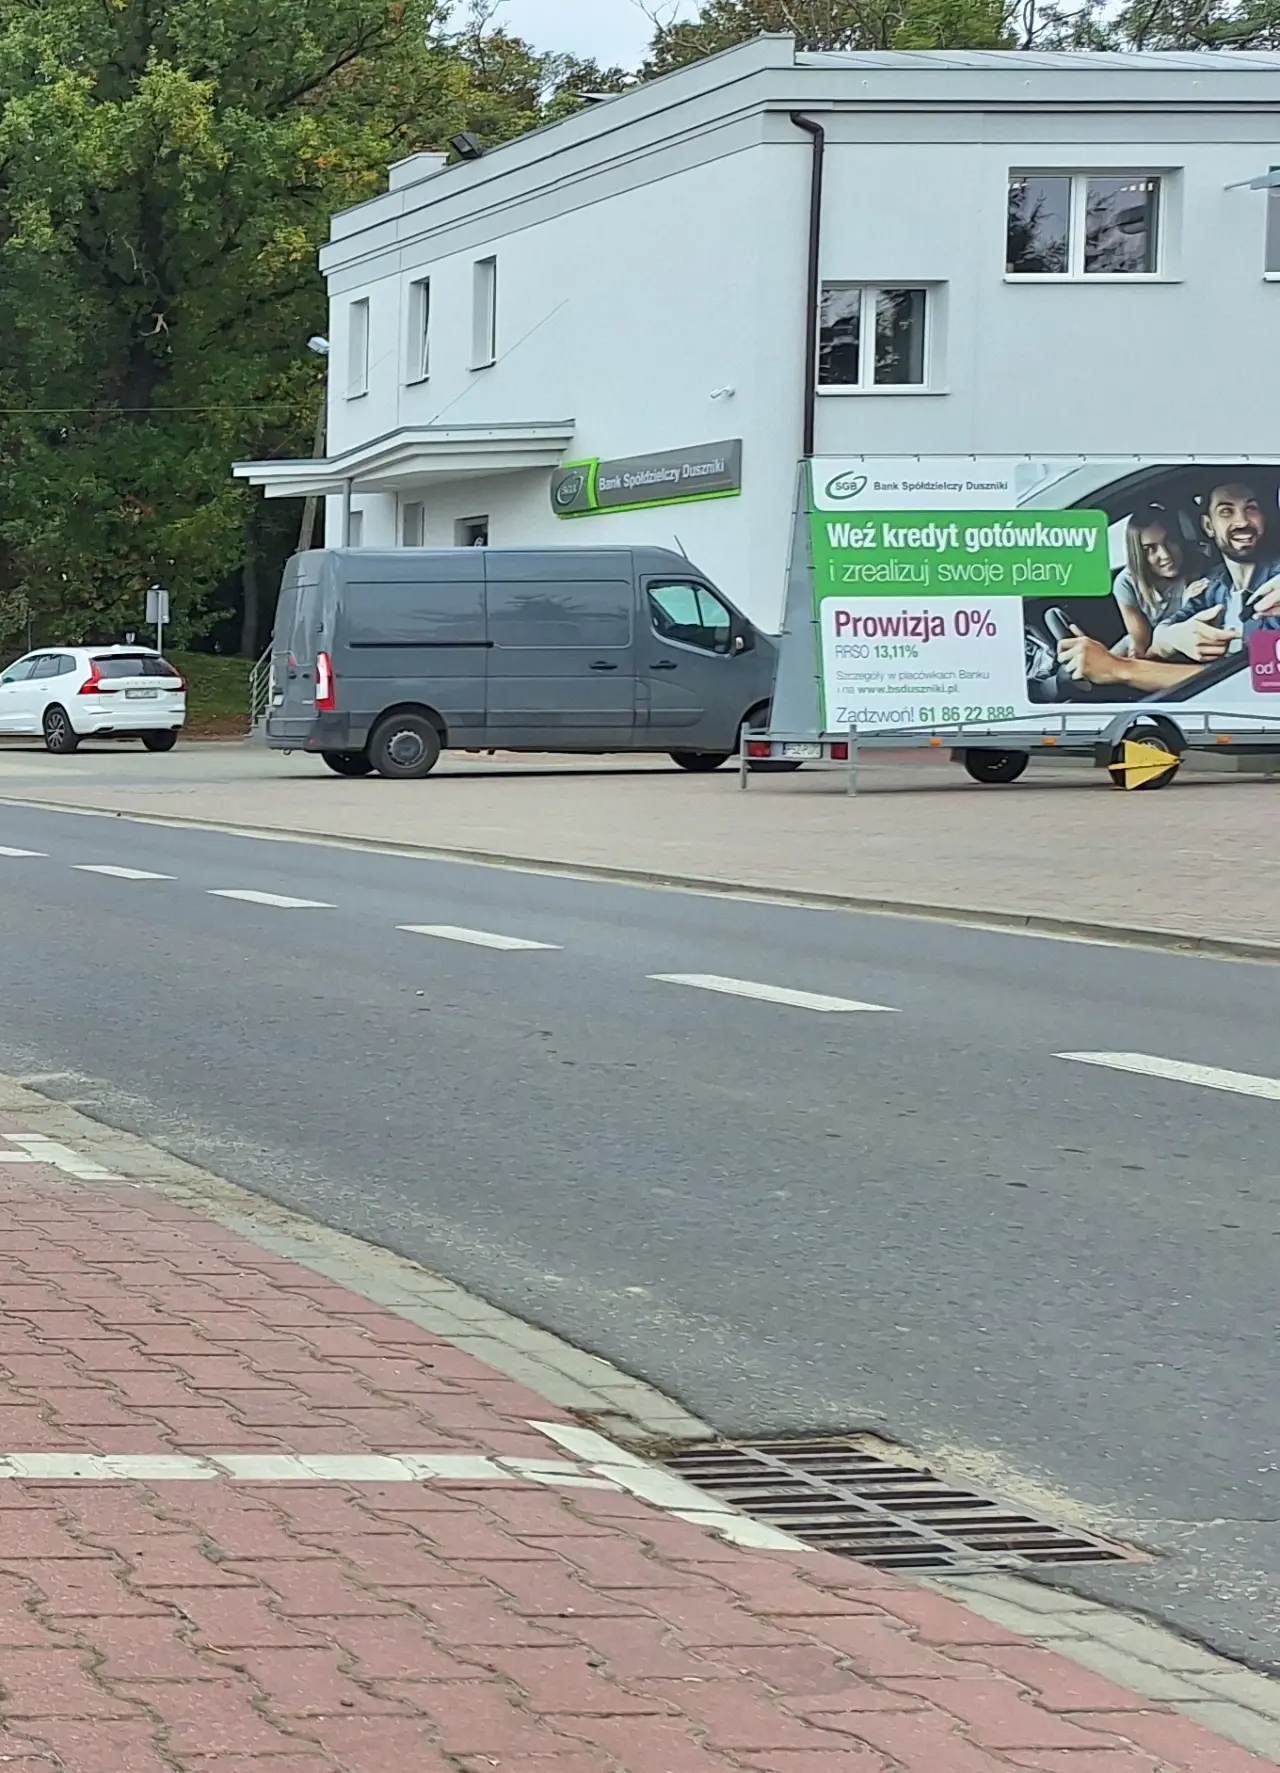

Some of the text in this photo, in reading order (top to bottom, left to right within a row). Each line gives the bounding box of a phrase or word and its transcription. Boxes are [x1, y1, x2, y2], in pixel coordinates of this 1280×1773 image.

[599, 478, 621, 492] Bank
[623, 468, 680, 489] Spółdzielczy
[682, 457, 725, 479] Duszniki
[835, 482, 858, 491] SGB
[873, 481, 1008, 492] Bank Spółdzielczy Duszniki
[826, 520, 1098, 553] Weź kredyt gotówkowy
[829, 558, 1073, 586] i zrealizuj swoje plany
[835, 609, 997, 643] Prowizja 0%
[835, 645, 919, 660] RRSO 13,11%
[958, 669, 990, 680] Banku
[1255, 661, 1276, 675] od
[836, 704, 1016, 723] Zadzwoń! 61 86 22 888
